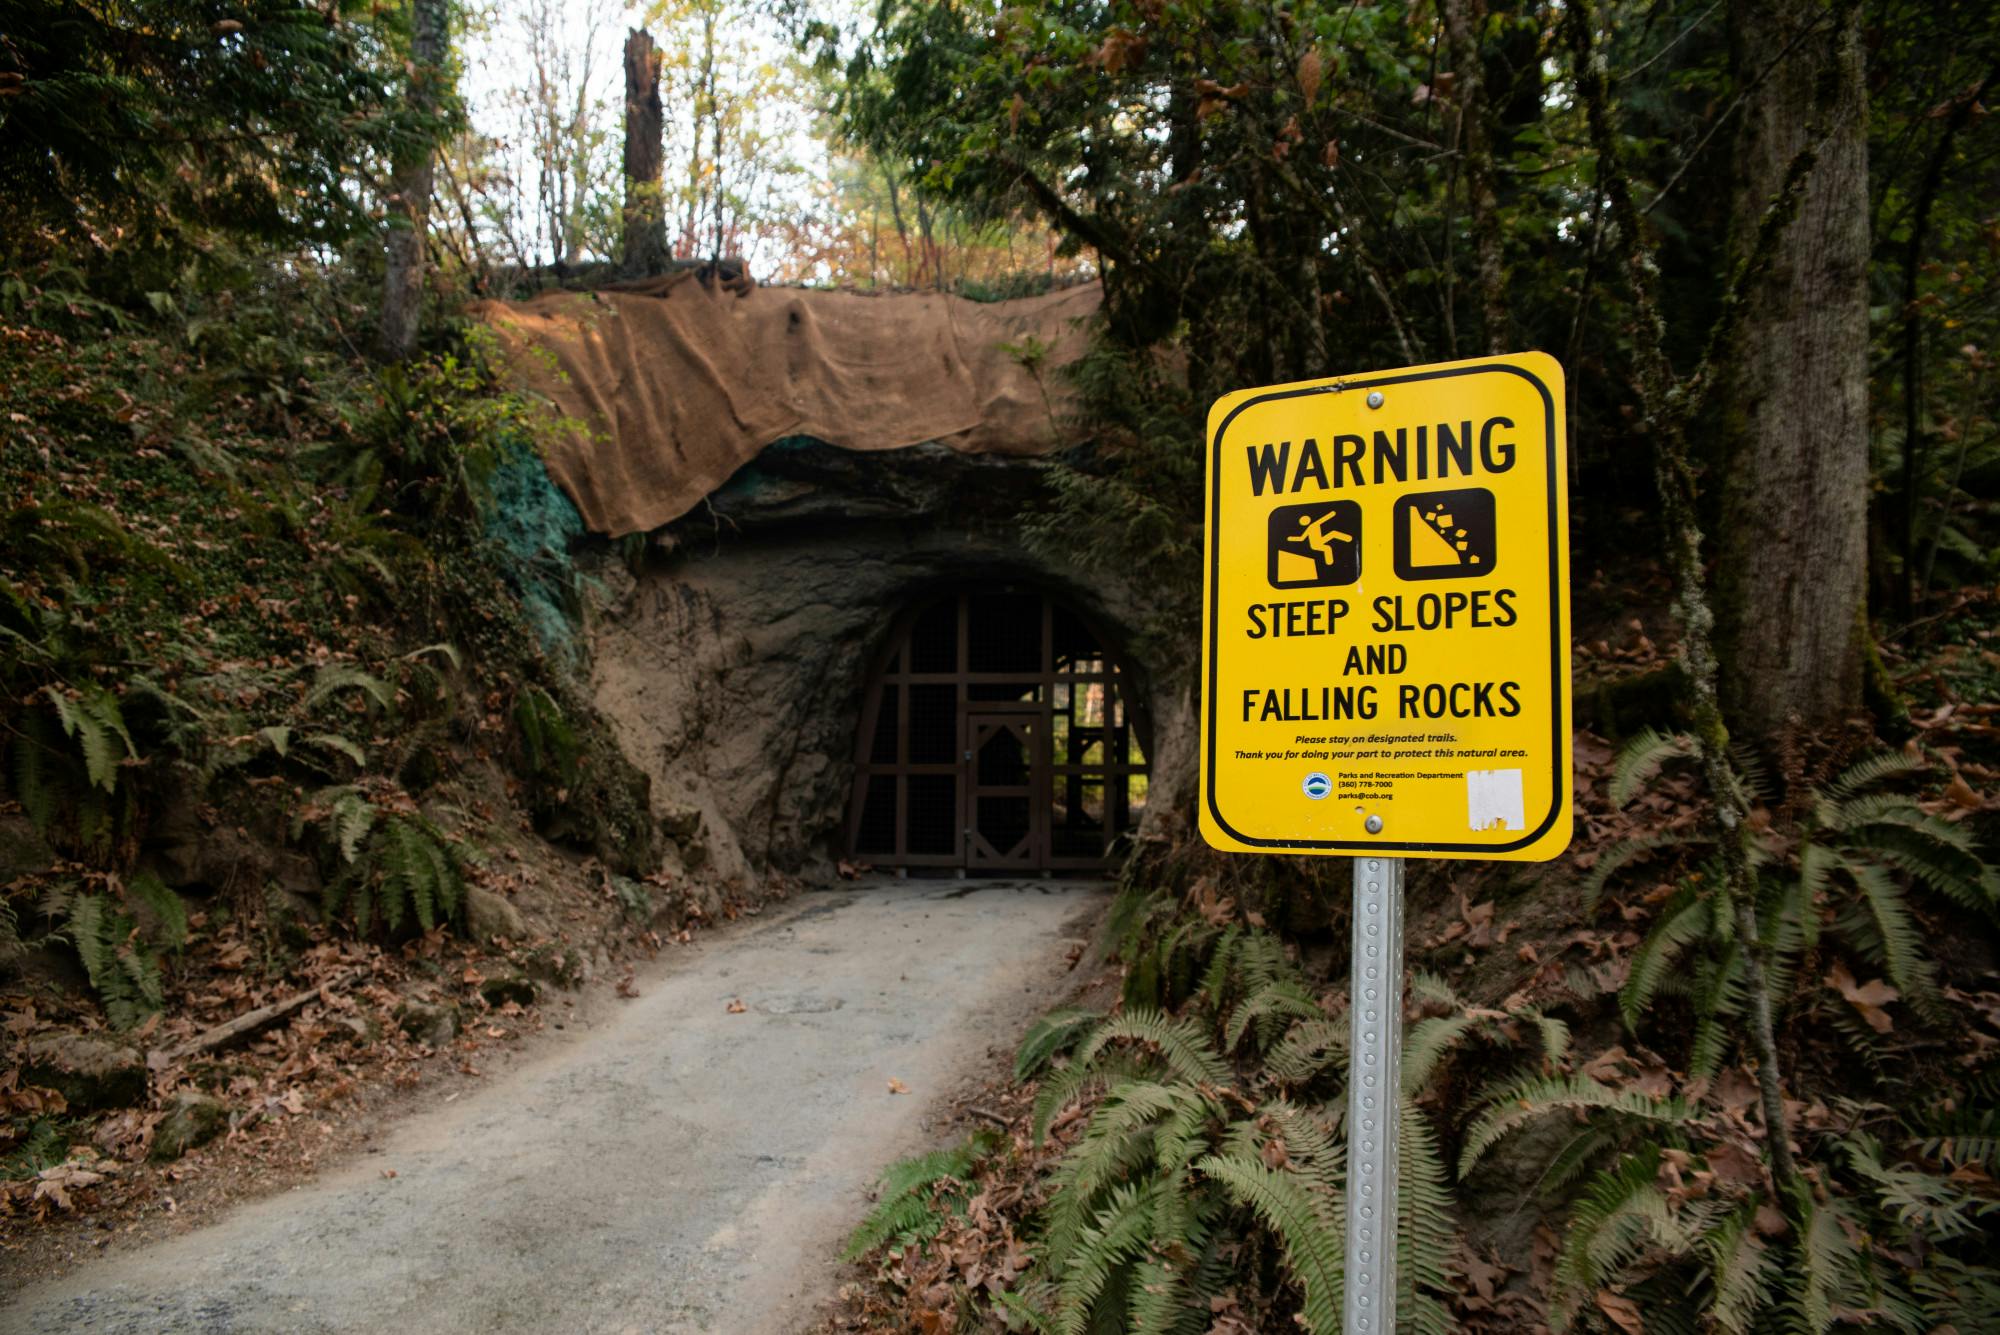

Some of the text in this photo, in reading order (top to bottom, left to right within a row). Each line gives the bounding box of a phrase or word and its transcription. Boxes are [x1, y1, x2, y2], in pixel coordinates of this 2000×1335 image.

[1247, 417, 1516, 497] WARNING
[1246, 589, 1517, 639] STEEP SLOPES
[1343, 644, 1407, 676] AND
[1243, 682, 1521, 722] FALLING ROCKS
[1296, 732, 1458, 746] Please stay on designated trails.
[1235, 747, 1529, 761] Thank you for doing your part to protect this natural area.
[1339, 771, 1464, 780] Parks and Recreation Department
[1339, 780, 1358, 789] (360)
[1339, 792, 1393, 801] parks@cob.org
